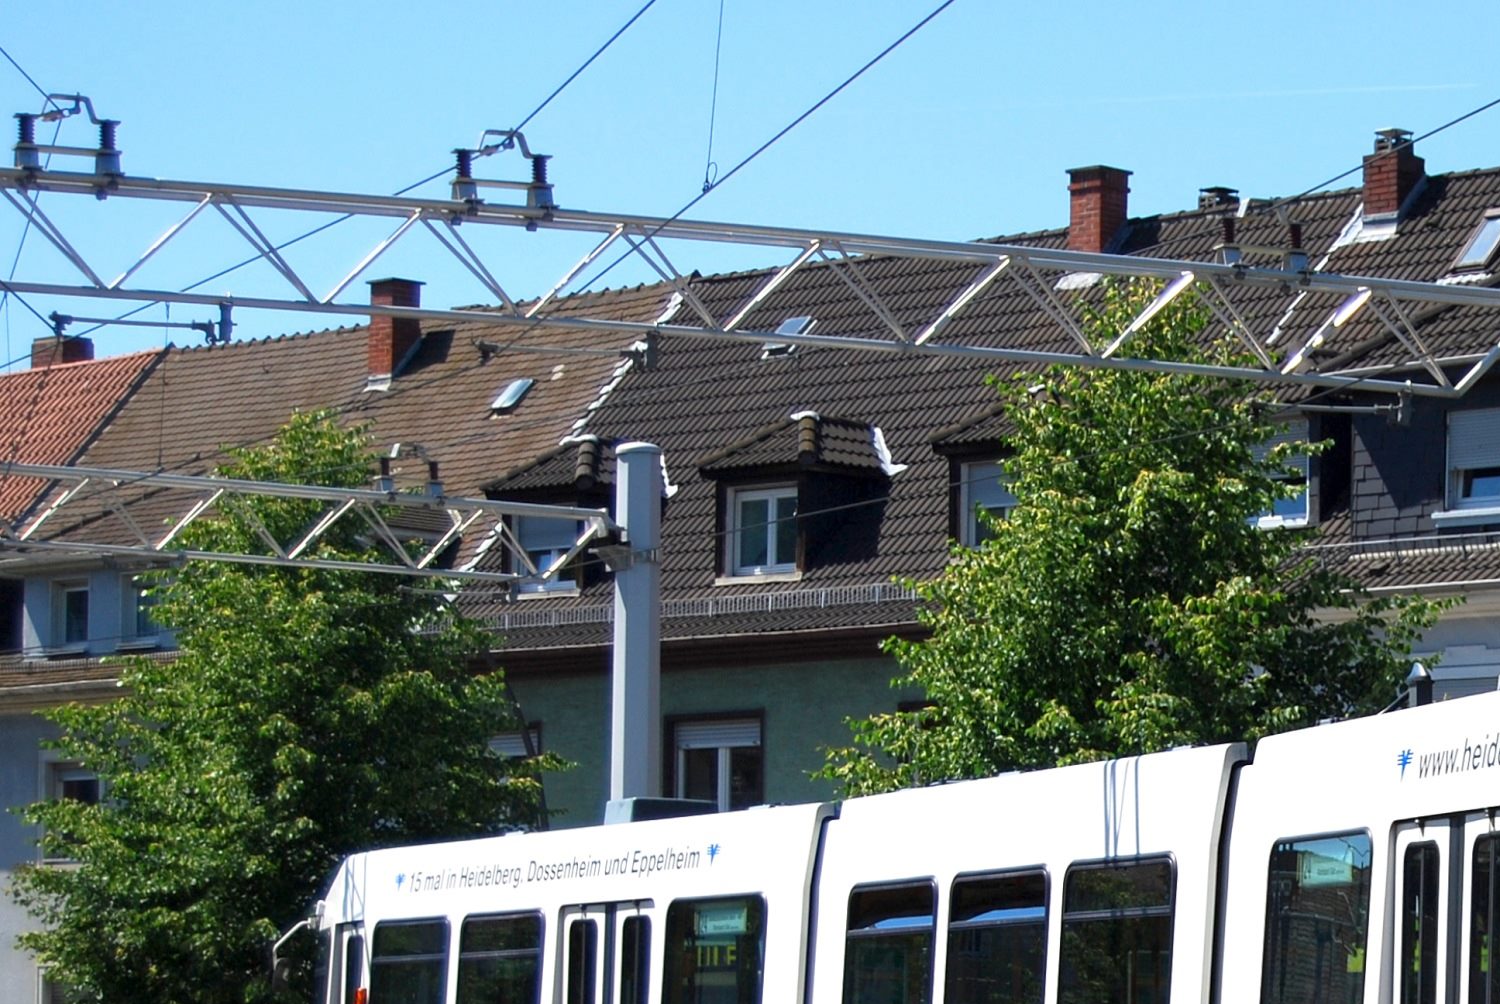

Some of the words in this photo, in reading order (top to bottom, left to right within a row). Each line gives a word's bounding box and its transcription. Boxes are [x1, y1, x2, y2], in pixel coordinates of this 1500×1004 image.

[409, 871, 422, 893] 15
[423, 870, 445, 891] mal
[446, 870, 456, 888] in
[527, 855, 601, 883] Dossenheim
[604, 851, 630, 876] und
[631, 846, 701, 877] Eppelheim
